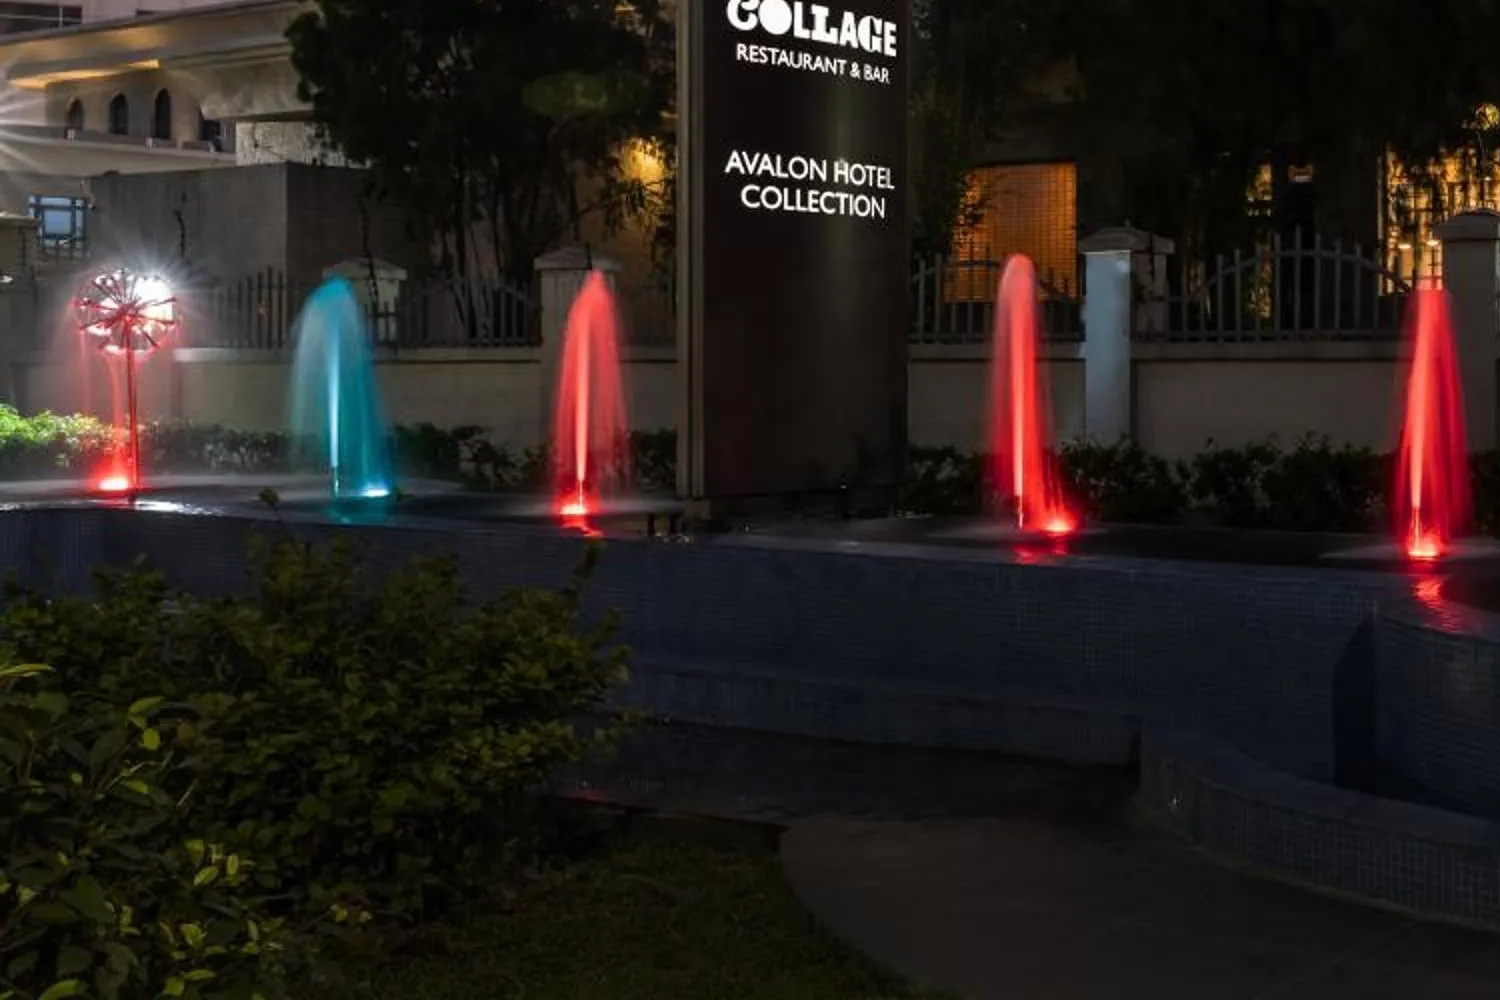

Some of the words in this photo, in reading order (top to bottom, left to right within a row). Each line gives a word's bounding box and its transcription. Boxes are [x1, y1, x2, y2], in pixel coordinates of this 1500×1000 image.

[736, 42, 847, 76] RESTAURANT
[849, 61, 861, 79] &
[863, 63, 890, 84] BAR
[724, 150, 828, 182] AVALON
[833, 161, 895, 190] HOTEL
[740, 183, 885, 219] COLLECTION
